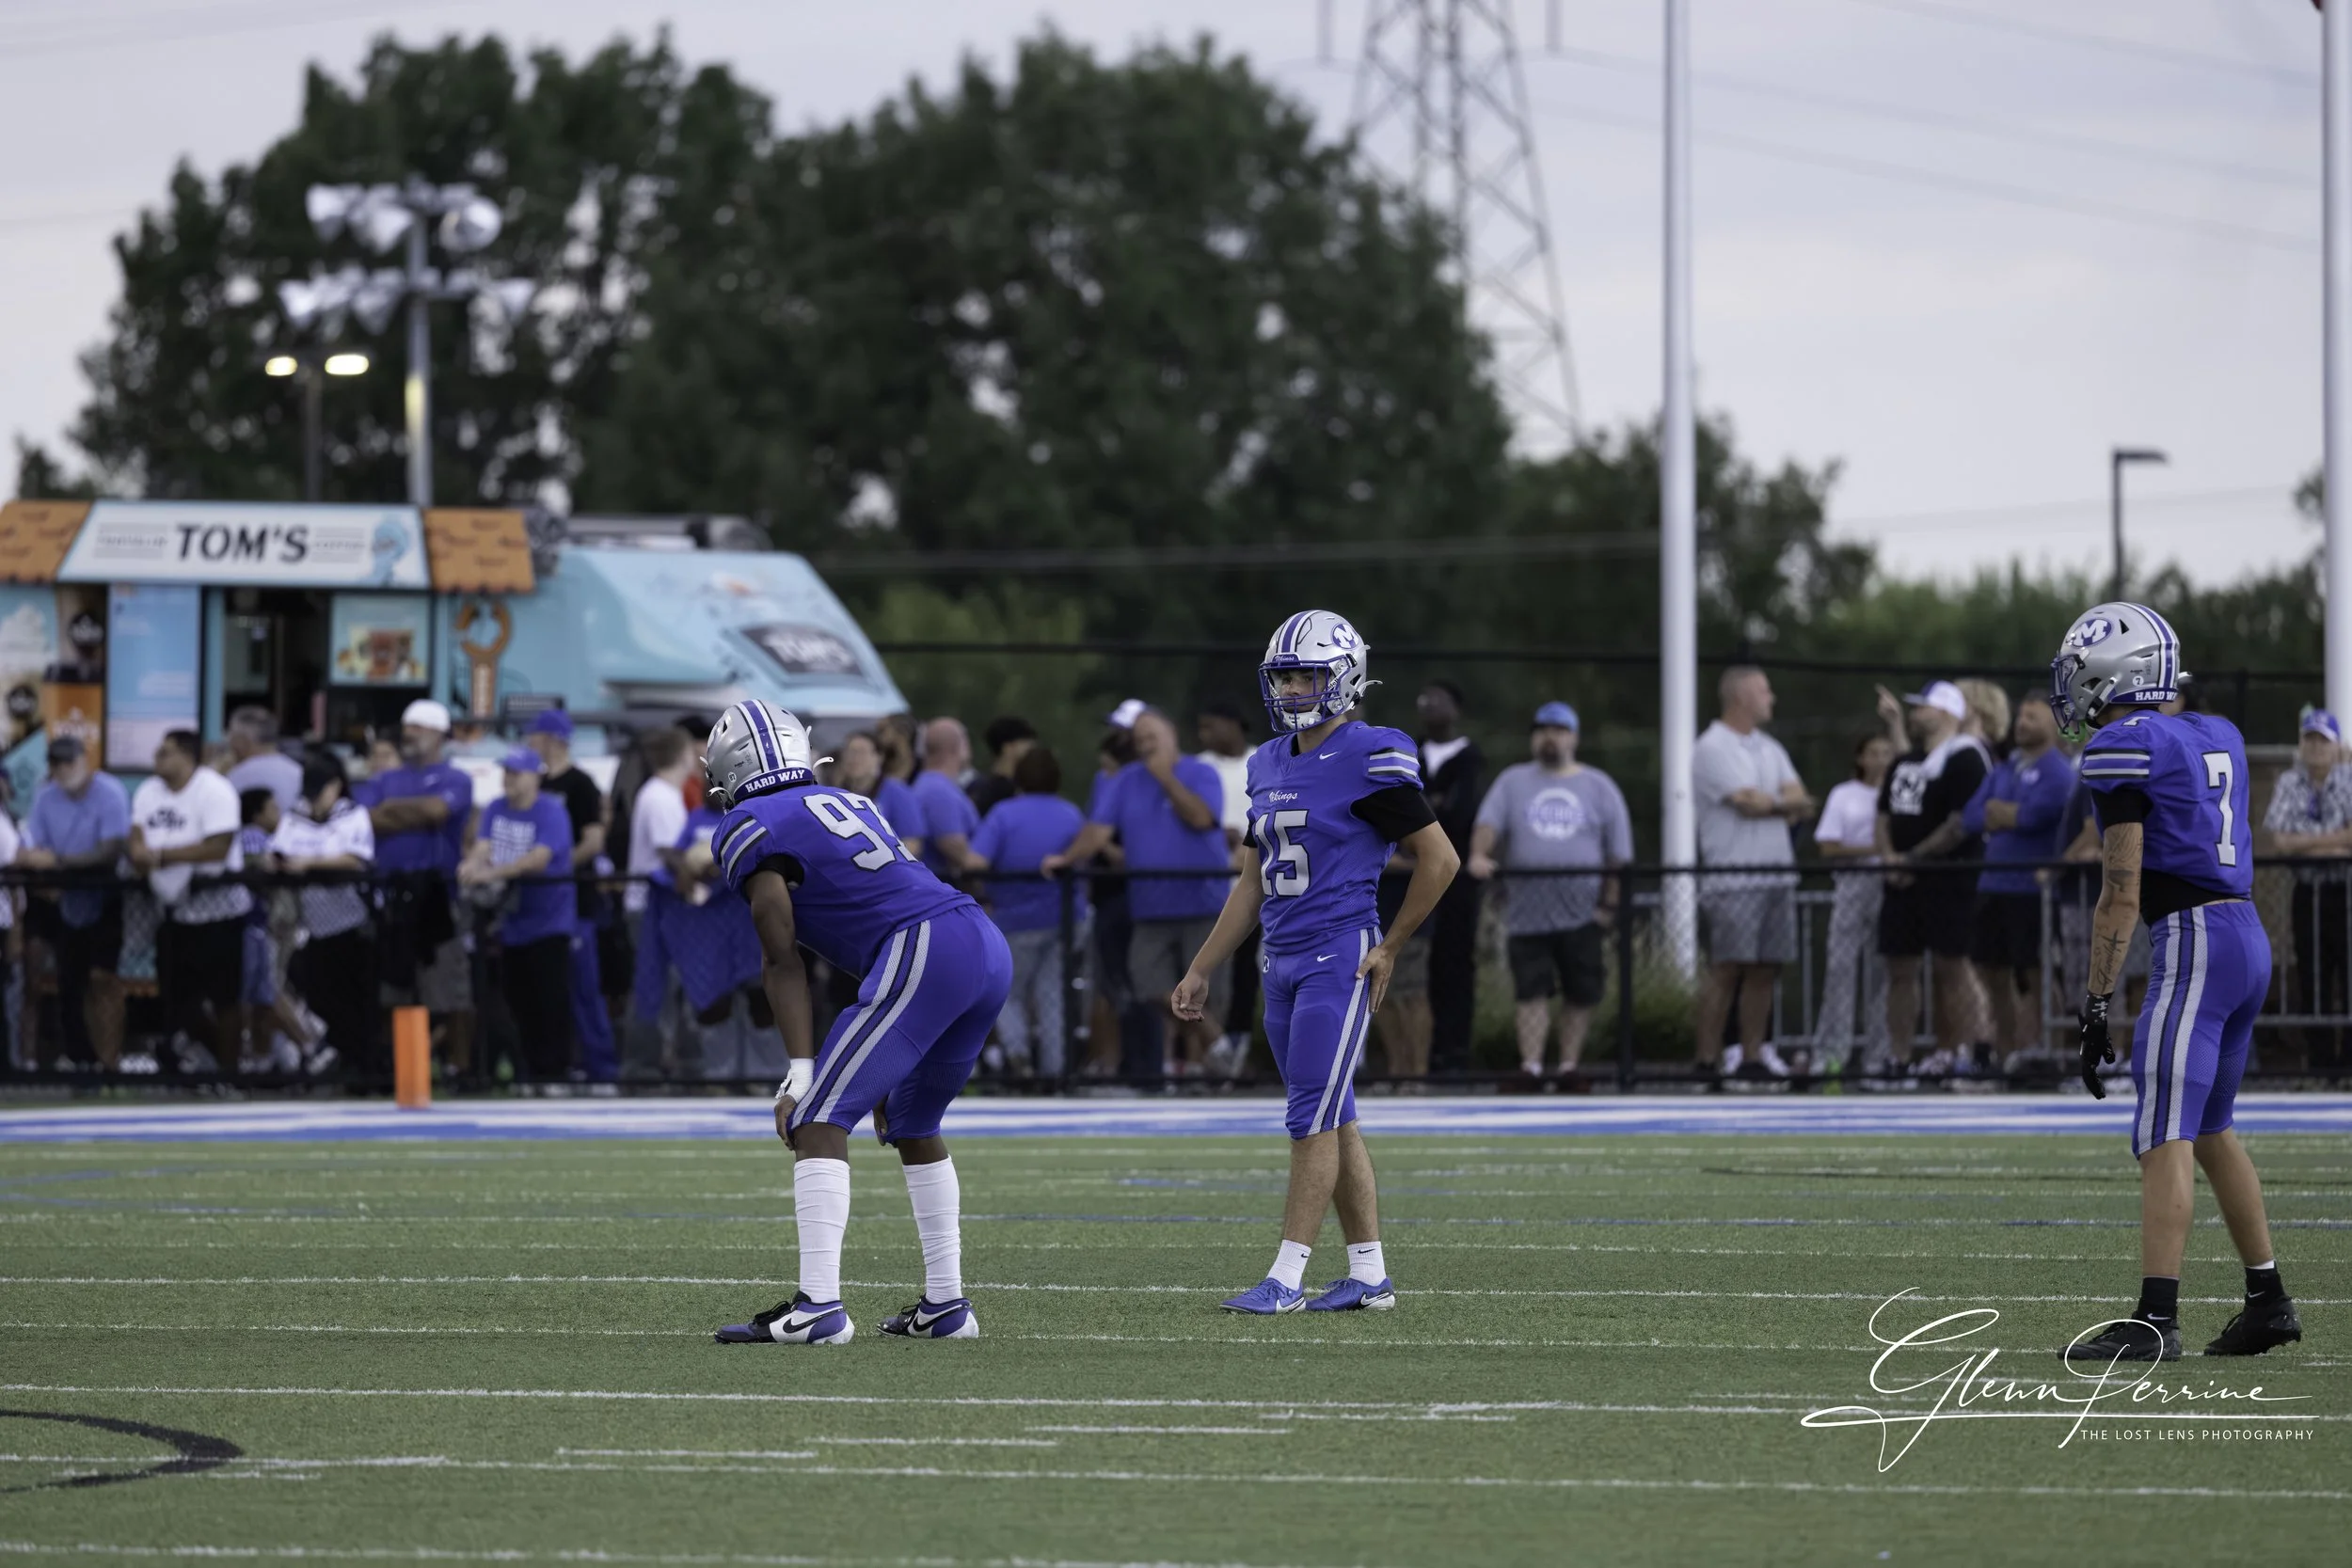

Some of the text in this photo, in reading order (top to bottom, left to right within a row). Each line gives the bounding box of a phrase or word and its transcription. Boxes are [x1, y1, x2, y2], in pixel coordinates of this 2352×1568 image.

[175, 524, 310, 563] TOM'S
[1333, 624, 1359, 648] M
[2073, 620, 2108, 647] M
[2135, 691, 2166, 702] HARD
[744, 769, 805, 793] HARD WAY
[2202, 751, 2236, 867] 7
[1254, 809, 1311, 897] 15
